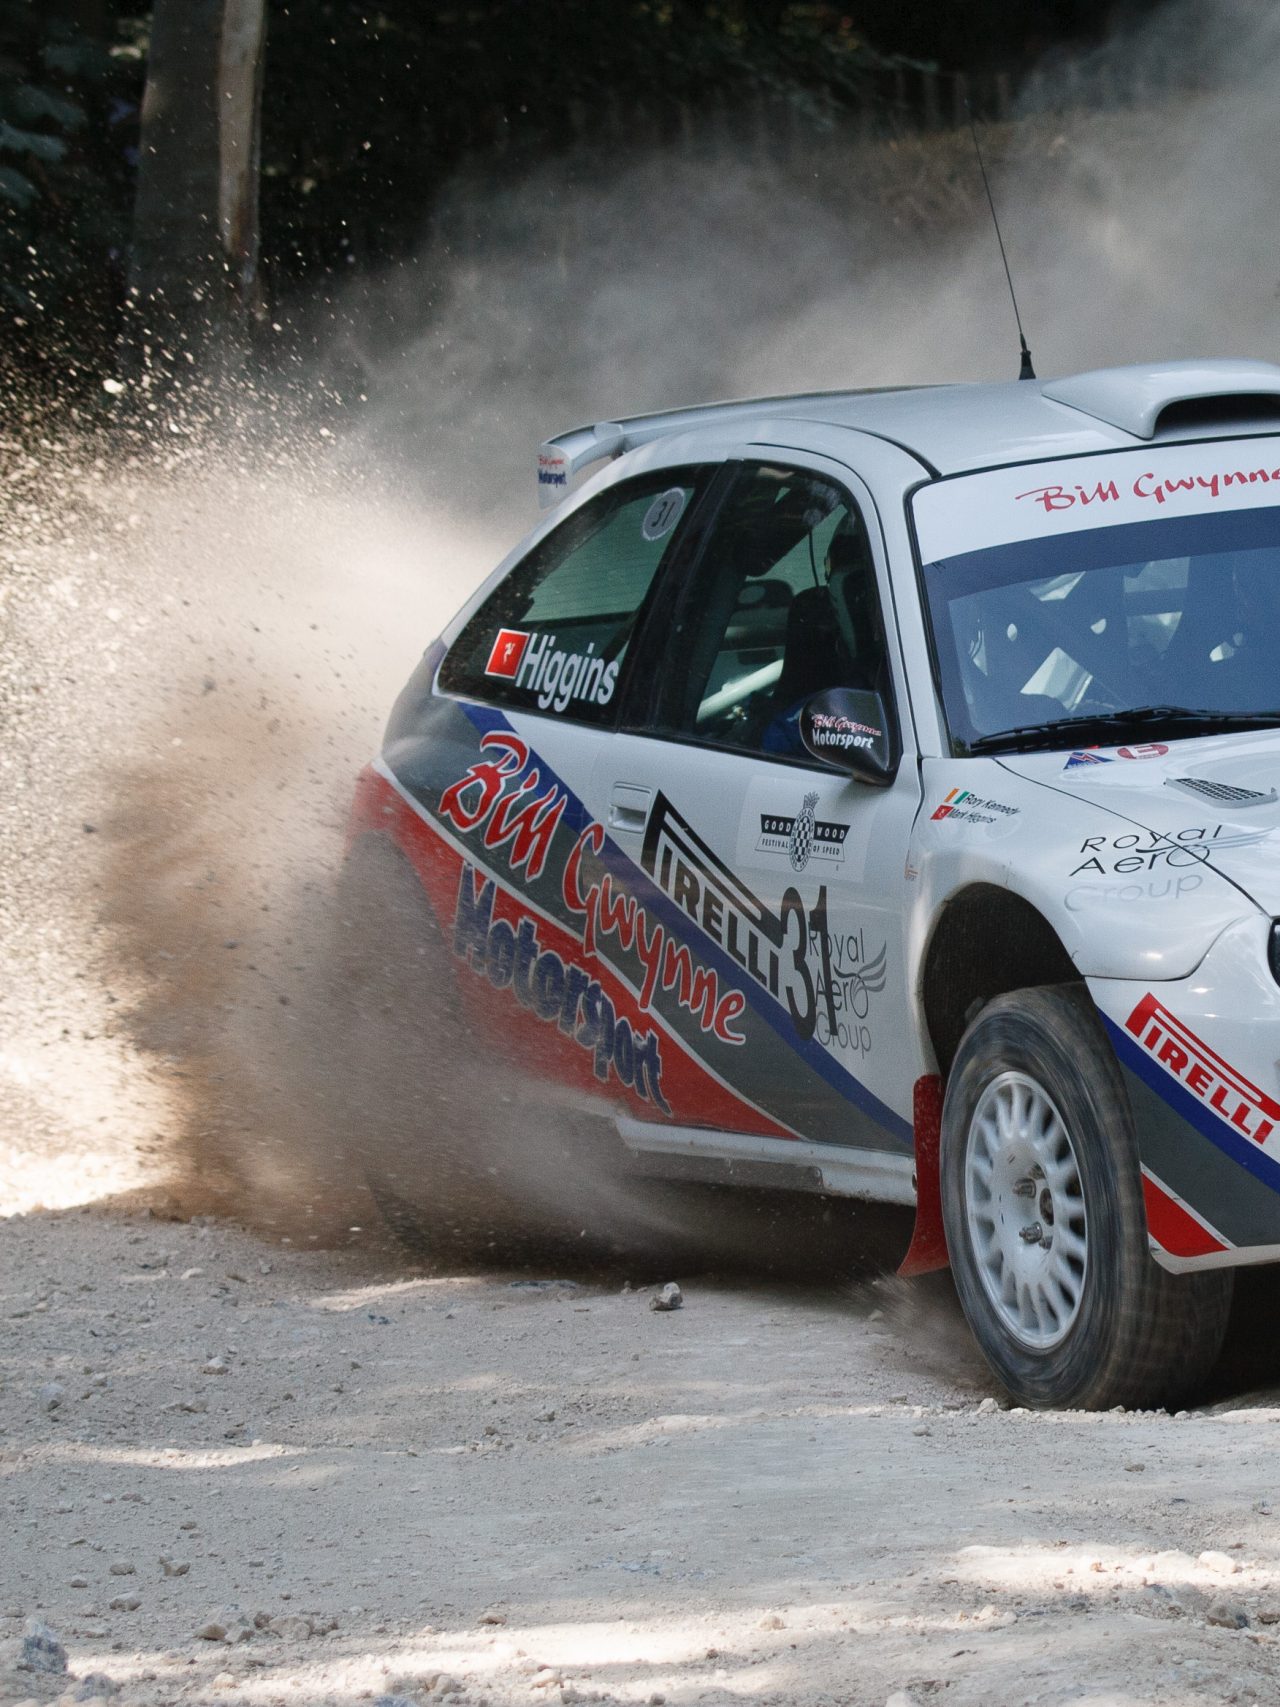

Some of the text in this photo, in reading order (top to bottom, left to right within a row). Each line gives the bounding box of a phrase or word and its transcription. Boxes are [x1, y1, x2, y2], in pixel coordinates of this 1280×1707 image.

[1015, 478, 1120, 512] Bill
[651, 501, 675, 527] 31
[515, 632, 620, 712] Higgins
[812, 728, 874, 749] Motorsport
[761, 838, 789, 849] FESTIVAL
[822, 847, 840, 856] SPEED
[1080, 825, 1223, 853] Royal
[439, 731, 746, 1046] Bill Gwynne
[640, 789, 785, 998] PIRELLI
[1064, 875, 1203, 911] Group
[780, 885, 838, 1040] 31
[452, 861, 673, 1116] Motorsport
